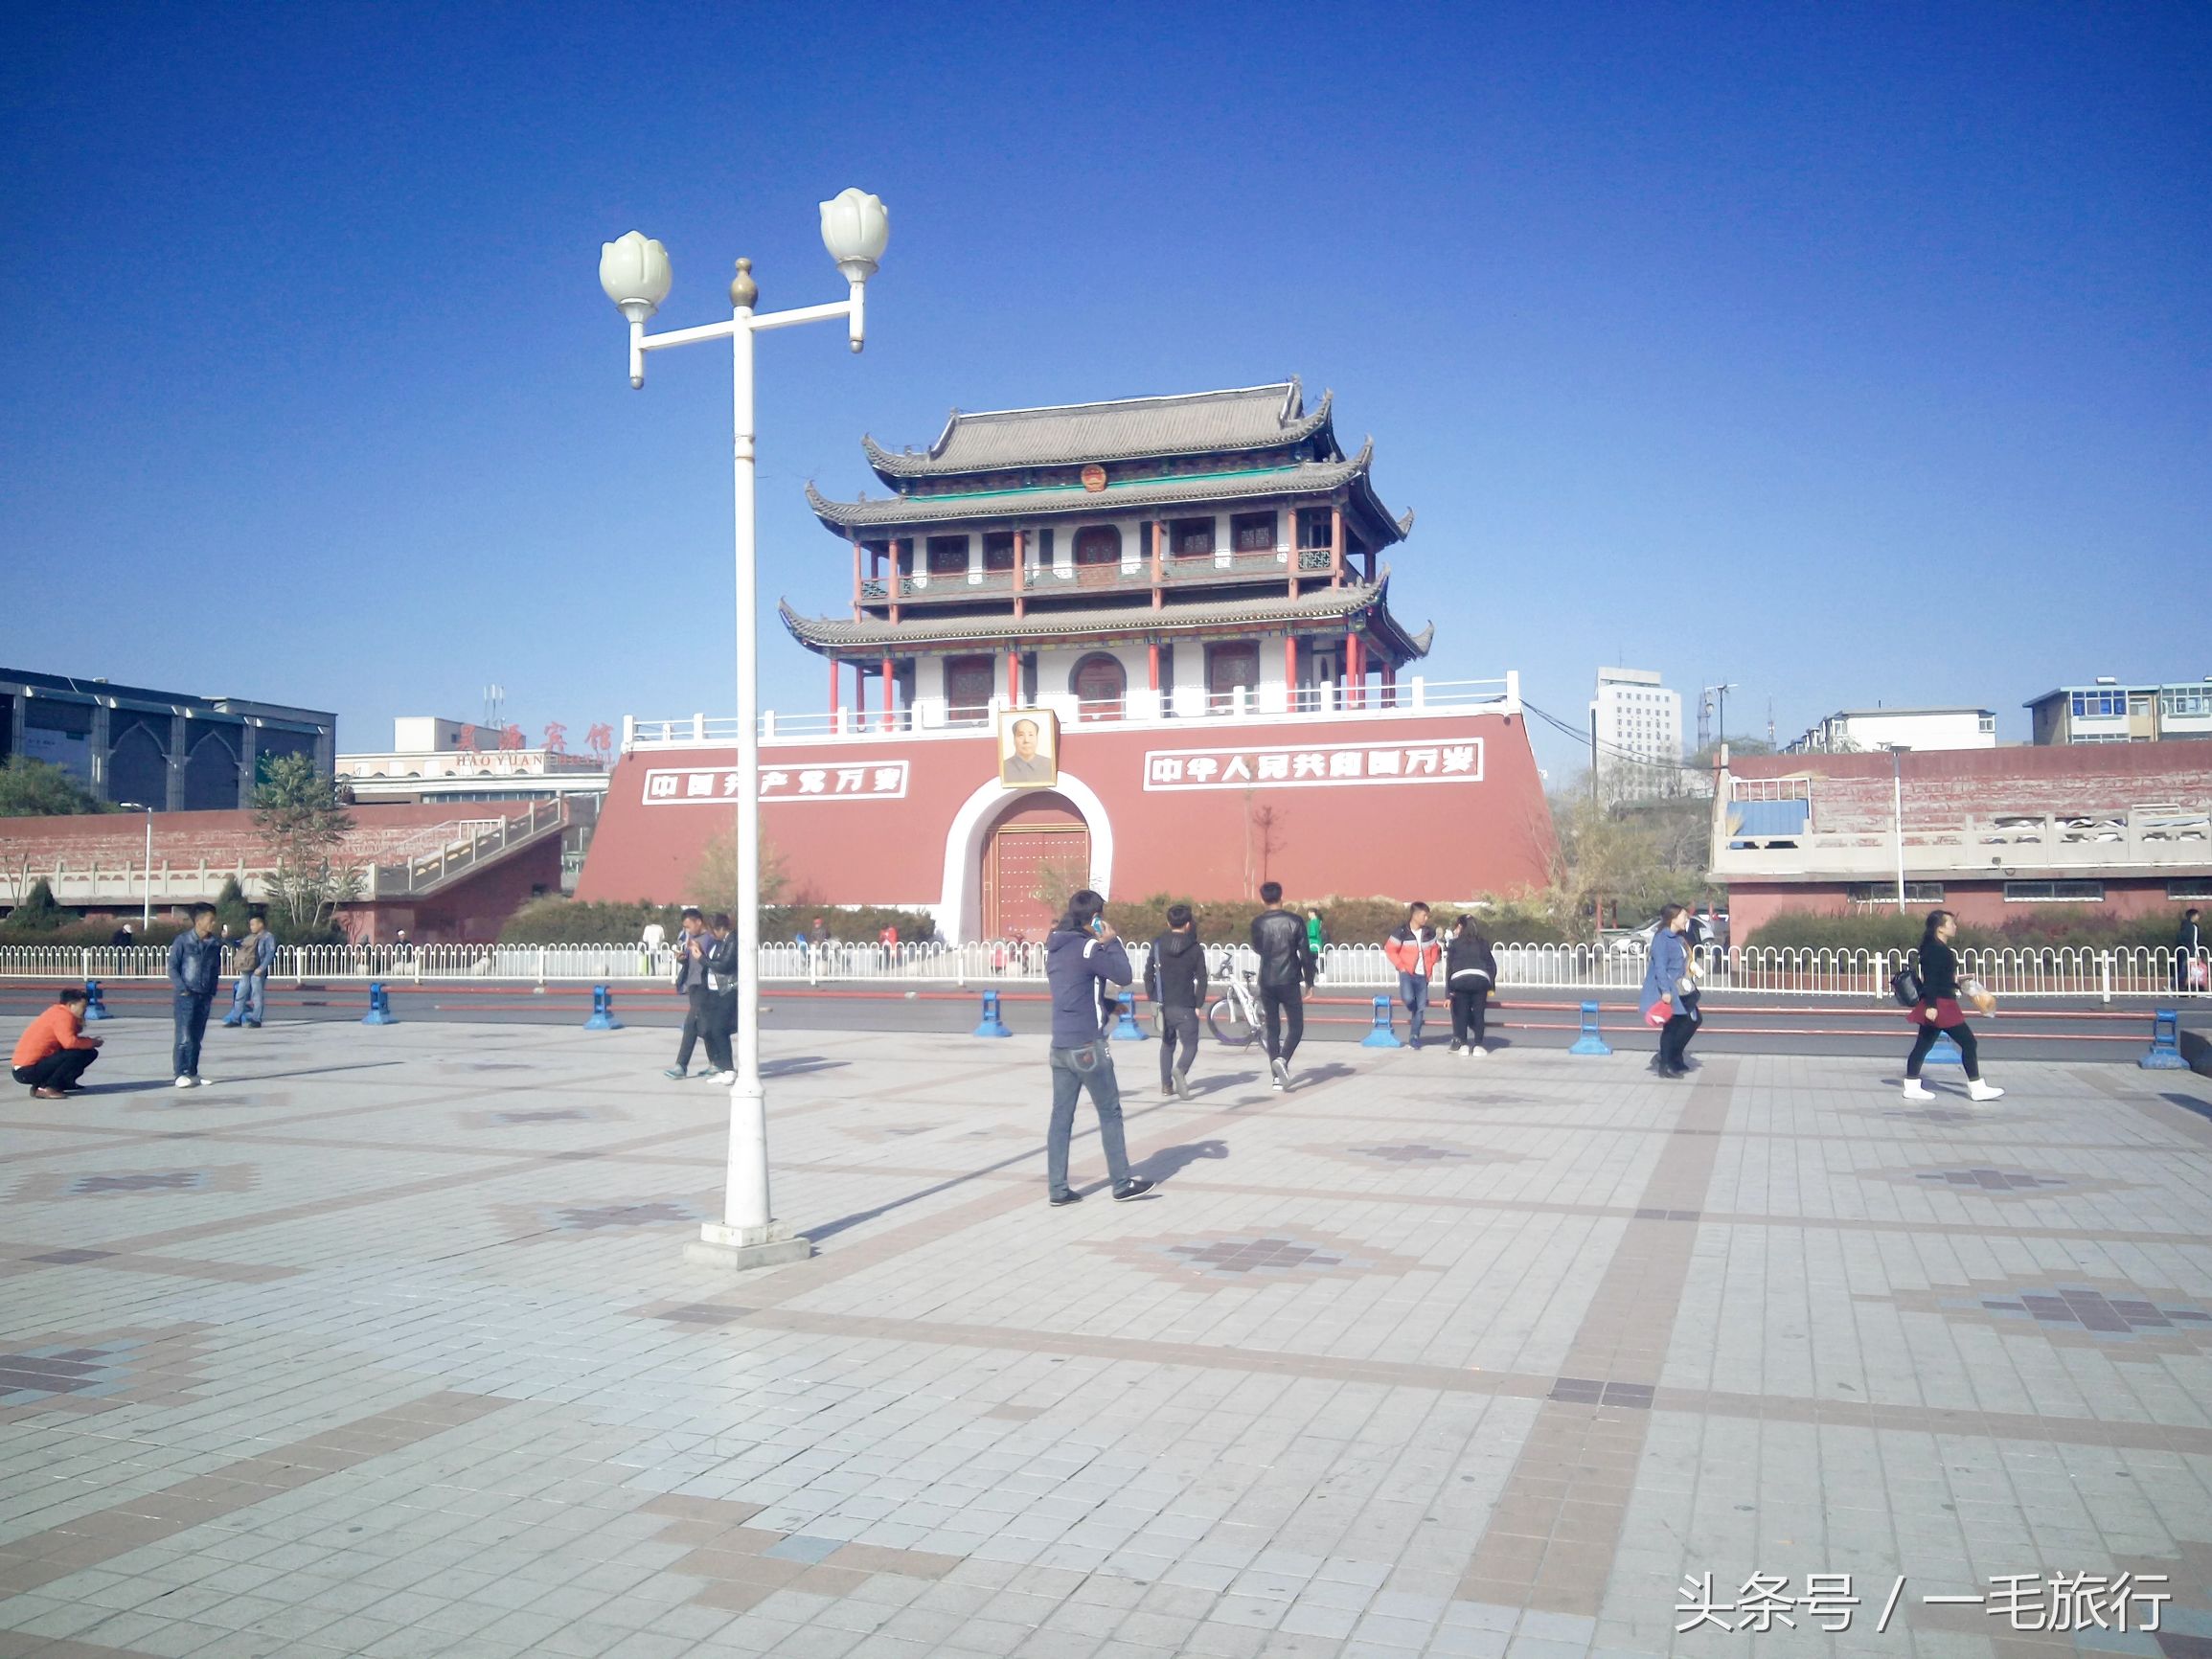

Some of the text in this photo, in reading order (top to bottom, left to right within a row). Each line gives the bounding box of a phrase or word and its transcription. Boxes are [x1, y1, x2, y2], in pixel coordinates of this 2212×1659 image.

[1152, 746, 1474, 783] 中华人民共和国万岁
